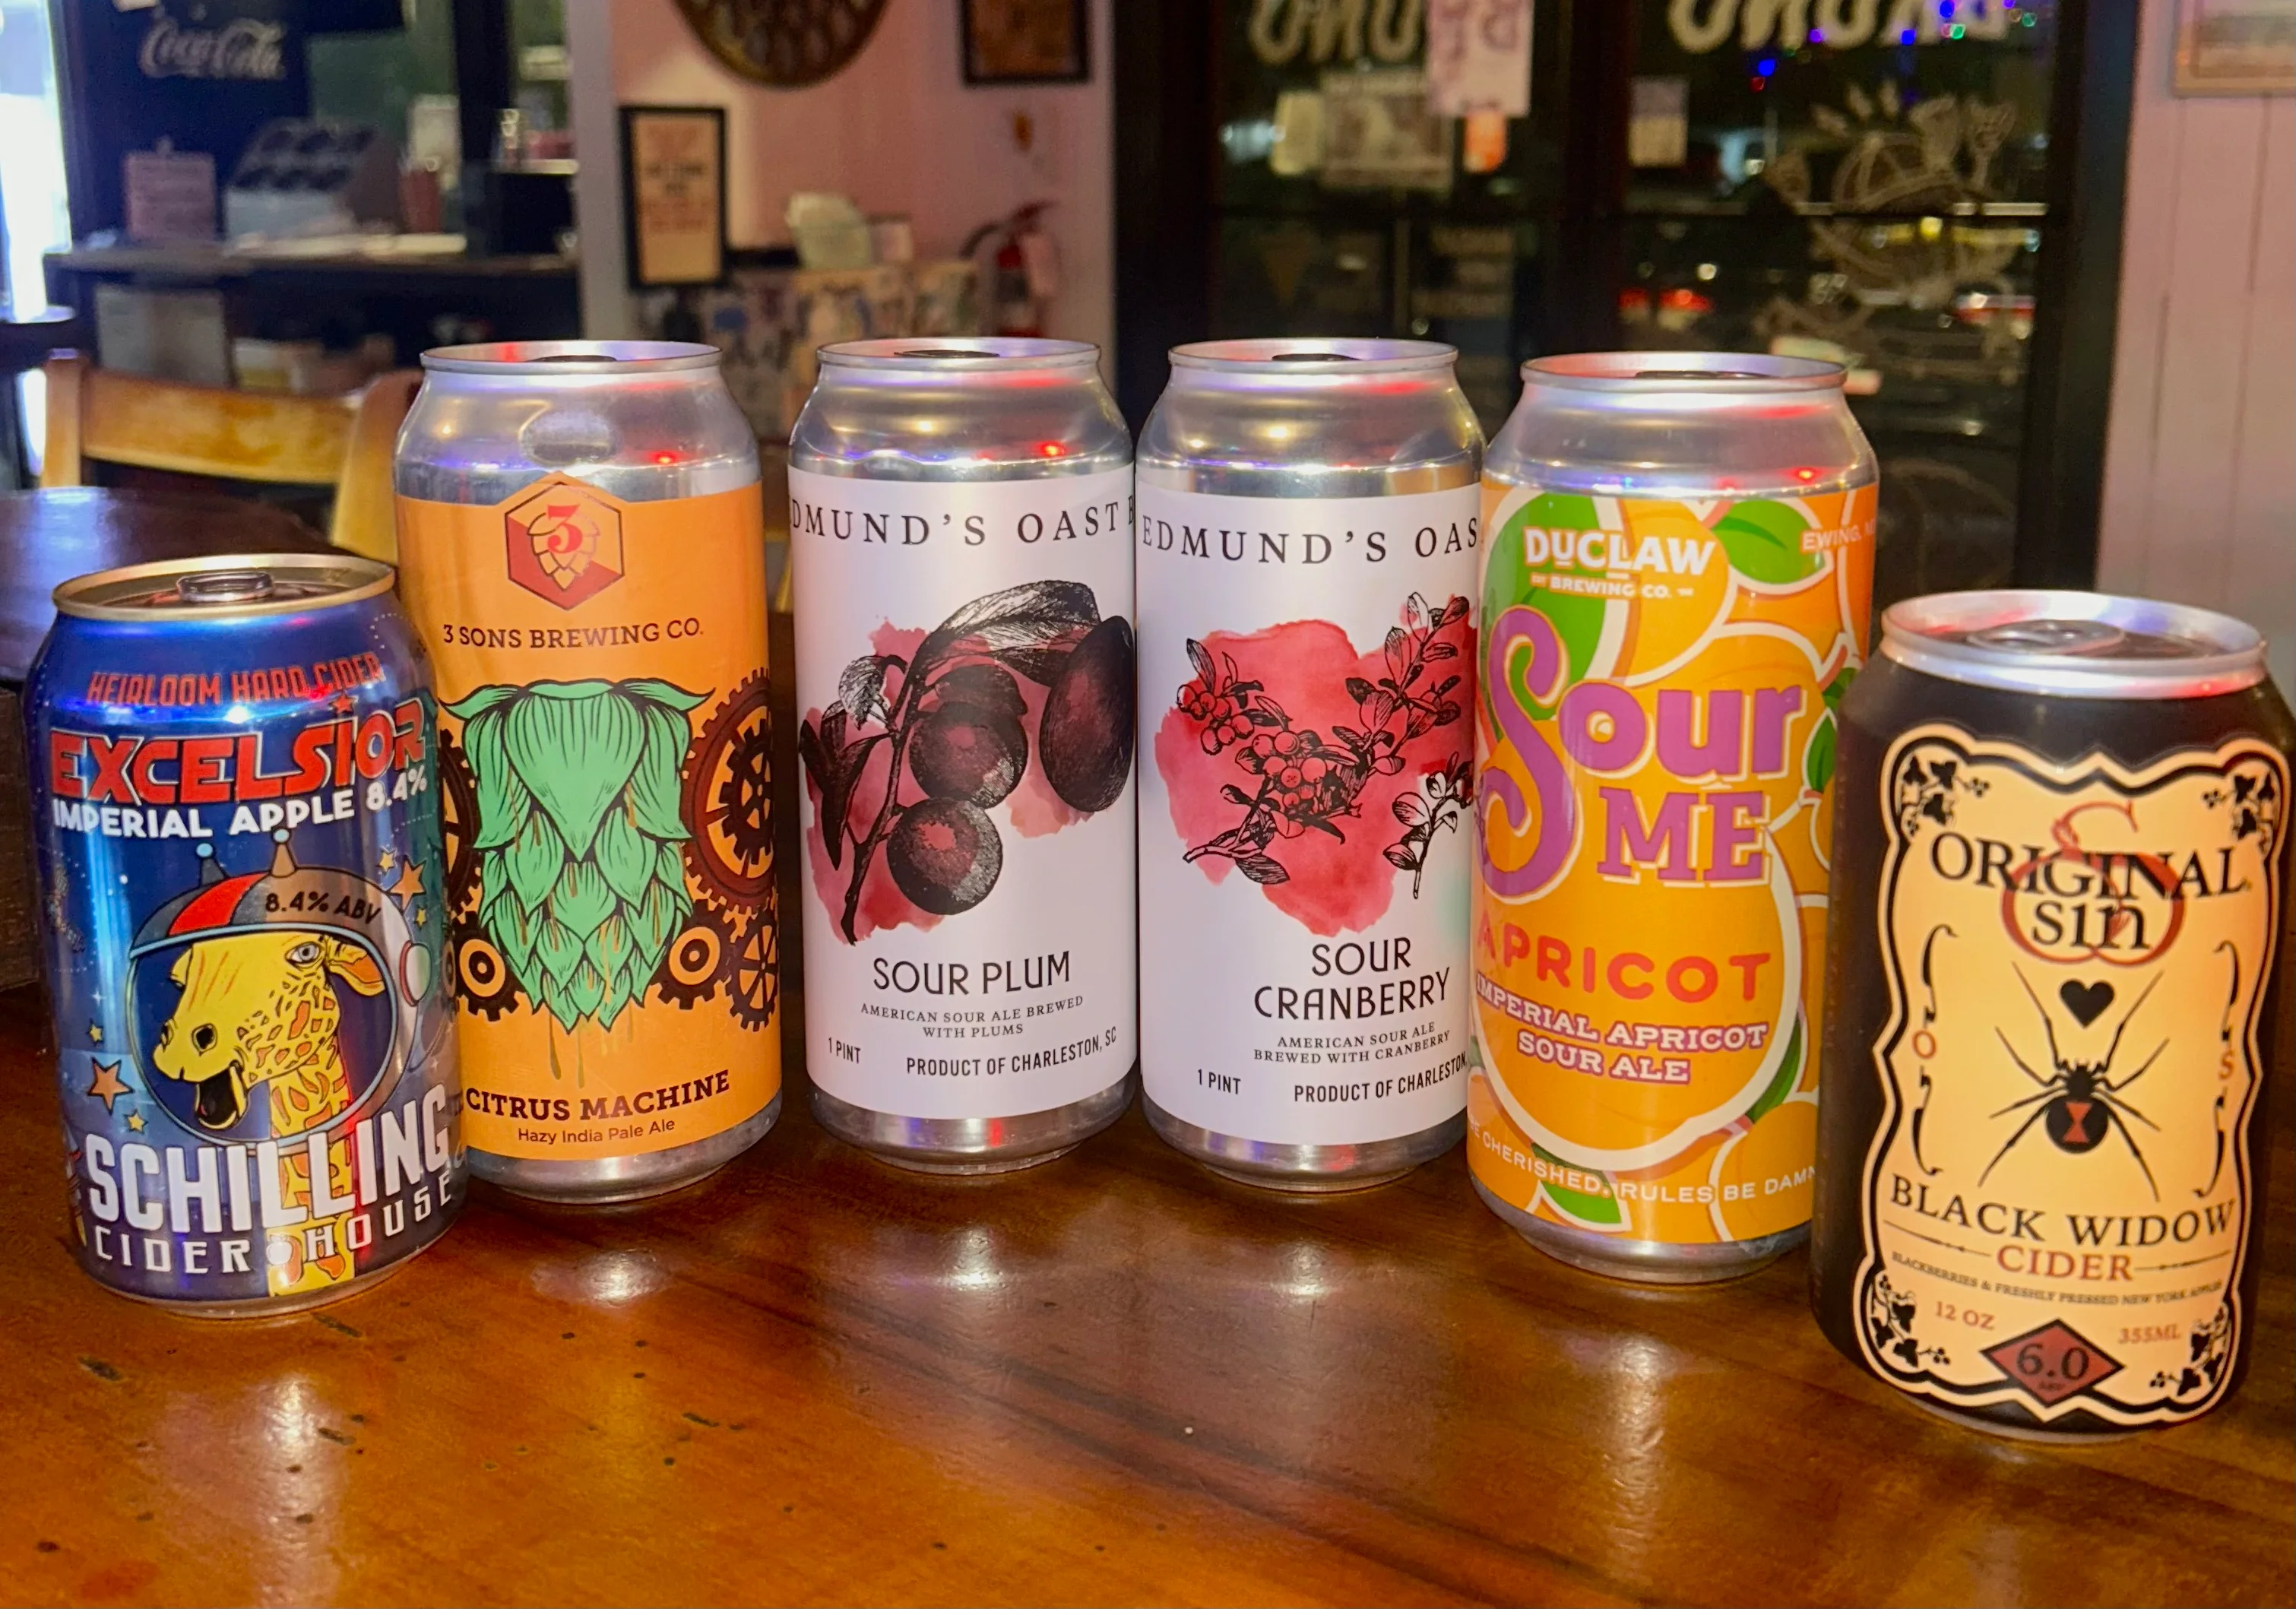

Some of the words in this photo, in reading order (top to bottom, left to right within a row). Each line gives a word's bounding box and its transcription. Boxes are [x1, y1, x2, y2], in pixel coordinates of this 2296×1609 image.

[791, 499, 986, 546] DMUND'S
[1017, 500, 1119, 544] OAST
[1142, 515, 1387, 565] EDMUND'S
[1414, 517, 1477, 558] OAS
[1550, 575, 1635, 597] BREWING
[1641, 584, 1673, 598] CO.
[443, 623, 454, 645] 3
[458, 626, 523, 649] SONS
[530, 621, 660, 650] BREWING
[666, 616, 705, 640] CO.
[87, 671, 222, 707] HEIRLOOM
[231, 665, 307, 702] HARD
[312, 651, 386, 691] CIDER
[50, 695, 426, 806] EXCELSIOR
[52, 800, 214, 840] IMPERIAL
[229, 789, 356, 836] APPLE
[366, 765, 428, 812] 8.4%
[1597, 785, 1771, 889] ME
[1930, 831, 2246, 900] ORIGINAL
[264, 891, 330, 914] 8.4%
[336, 898, 383, 925] ABV
[872, 956, 971, 996] SOUR
[981, 949, 1071, 996] PLUM
[1311, 936, 1412, 977] SOUR
[1477, 908, 1771, 1003] APRICOT
[860, 1002, 938, 1023] AMERICAN
[943, 1011, 986, 1023] SOUR
[991, 1008, 1021, 1021] ALE
[1026, 995, 1084, 1018] BREWED
[1254, 967, 1450, 1021] CRANBERRY
[1476, 971, 1599, 1042] IMPERIAL
[1606, 1021, 1769, 1052] APRICOT
[827, 1037, 833, 1054] 1
[836, 1040, 862, 1065] PINT
[907, 1057, 981, 1077] PRODUCT
[986, 1057, 1006, 1076] OF
[1012, 1034, 1103, 1073] CHARLESTON,
[1105, 1026, 1116, 1047] SC
[922, 1026, 965, 1038] WITH
[971, 1023, 1024, 1037] PLUMS
[1253, 1049, 1322, 1064] BREWED
[1327, 1050, 1369, 1064] WITH
[1375, 1030, 1451, 1060] CRANBERRY
[1277, 1035, 1364, 1049] AMERICAN
[1370, 1030, 1408, 1046] SOUR
[1411, 1021, 1436, 1037] ALE
[1518, 1029, 1603, 1075] SOUR
[1610, 1057, 1691, 1083] ALE
[465, 1087, 571, 1122] CITRUS
[578, 1069, 731, 1122] MACHINE
[1197, 1069, 1203, 1086] 1
[1208, 1071, 1242, 1095] PINT
[1294, 1082, 1370, 1103] PRODUCT
[1375, 1079, 1394, 1098] OF
[518, 1127, 557, 1145] Hazy
[562, 1128, 603, 1144] India
[608, 1125, 644, 1142] Pale
[648, 1118, 676, 1135] Ale
[85, 1082, 450, 1234] SCHILLING
[1620, 1182, 1715, 1204] RULES
[1722, 1183, 1756, 1202] BE
[1890, 1173, 2047, 1243] BLACK
[2065, 1198, 2236, 1248] WIDOW
[93, 1226, 252, 1275] CIDER
[304, 1168, 453, 1262] HOUSE
[1996, 1244, 2133, 1281] CIDER
[1935, 1300, 1958, 1321] 12
[1962, 1310, 1997, 1331] OZ
[2117, 1323, 2181, 1345] 355ML
[2121, 1294, 2151, 1306] NEW
[2016, 1342, 2090, 1381] 6.0
